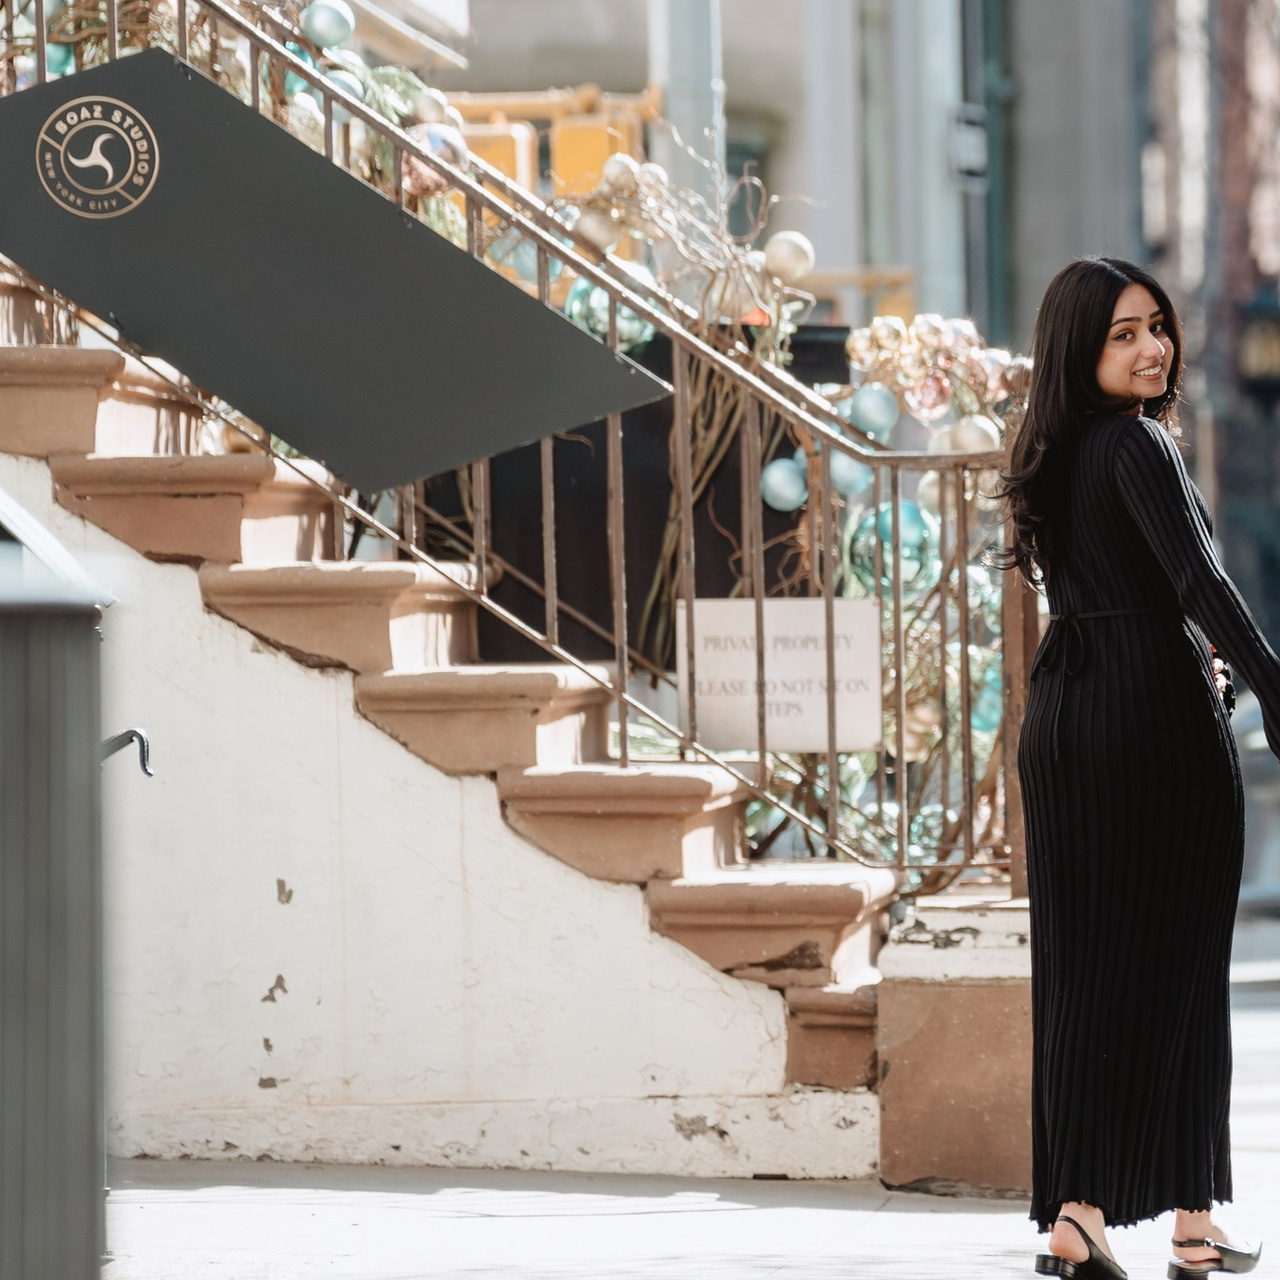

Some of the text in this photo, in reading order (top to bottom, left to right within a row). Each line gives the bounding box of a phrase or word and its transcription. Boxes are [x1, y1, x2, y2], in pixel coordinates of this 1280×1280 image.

[54, 104, 150, 187] BOAZ STUDIOS
[44, 151, 118, 211] NEW YORK CITY
[694, 678, 747, 697] LEASE
[780, 677, 814, 697] NOT
[818, 677, 843, 697] ST
[845, 676, 871, 696] ON
[765, 700, 805, 718] TEPS
